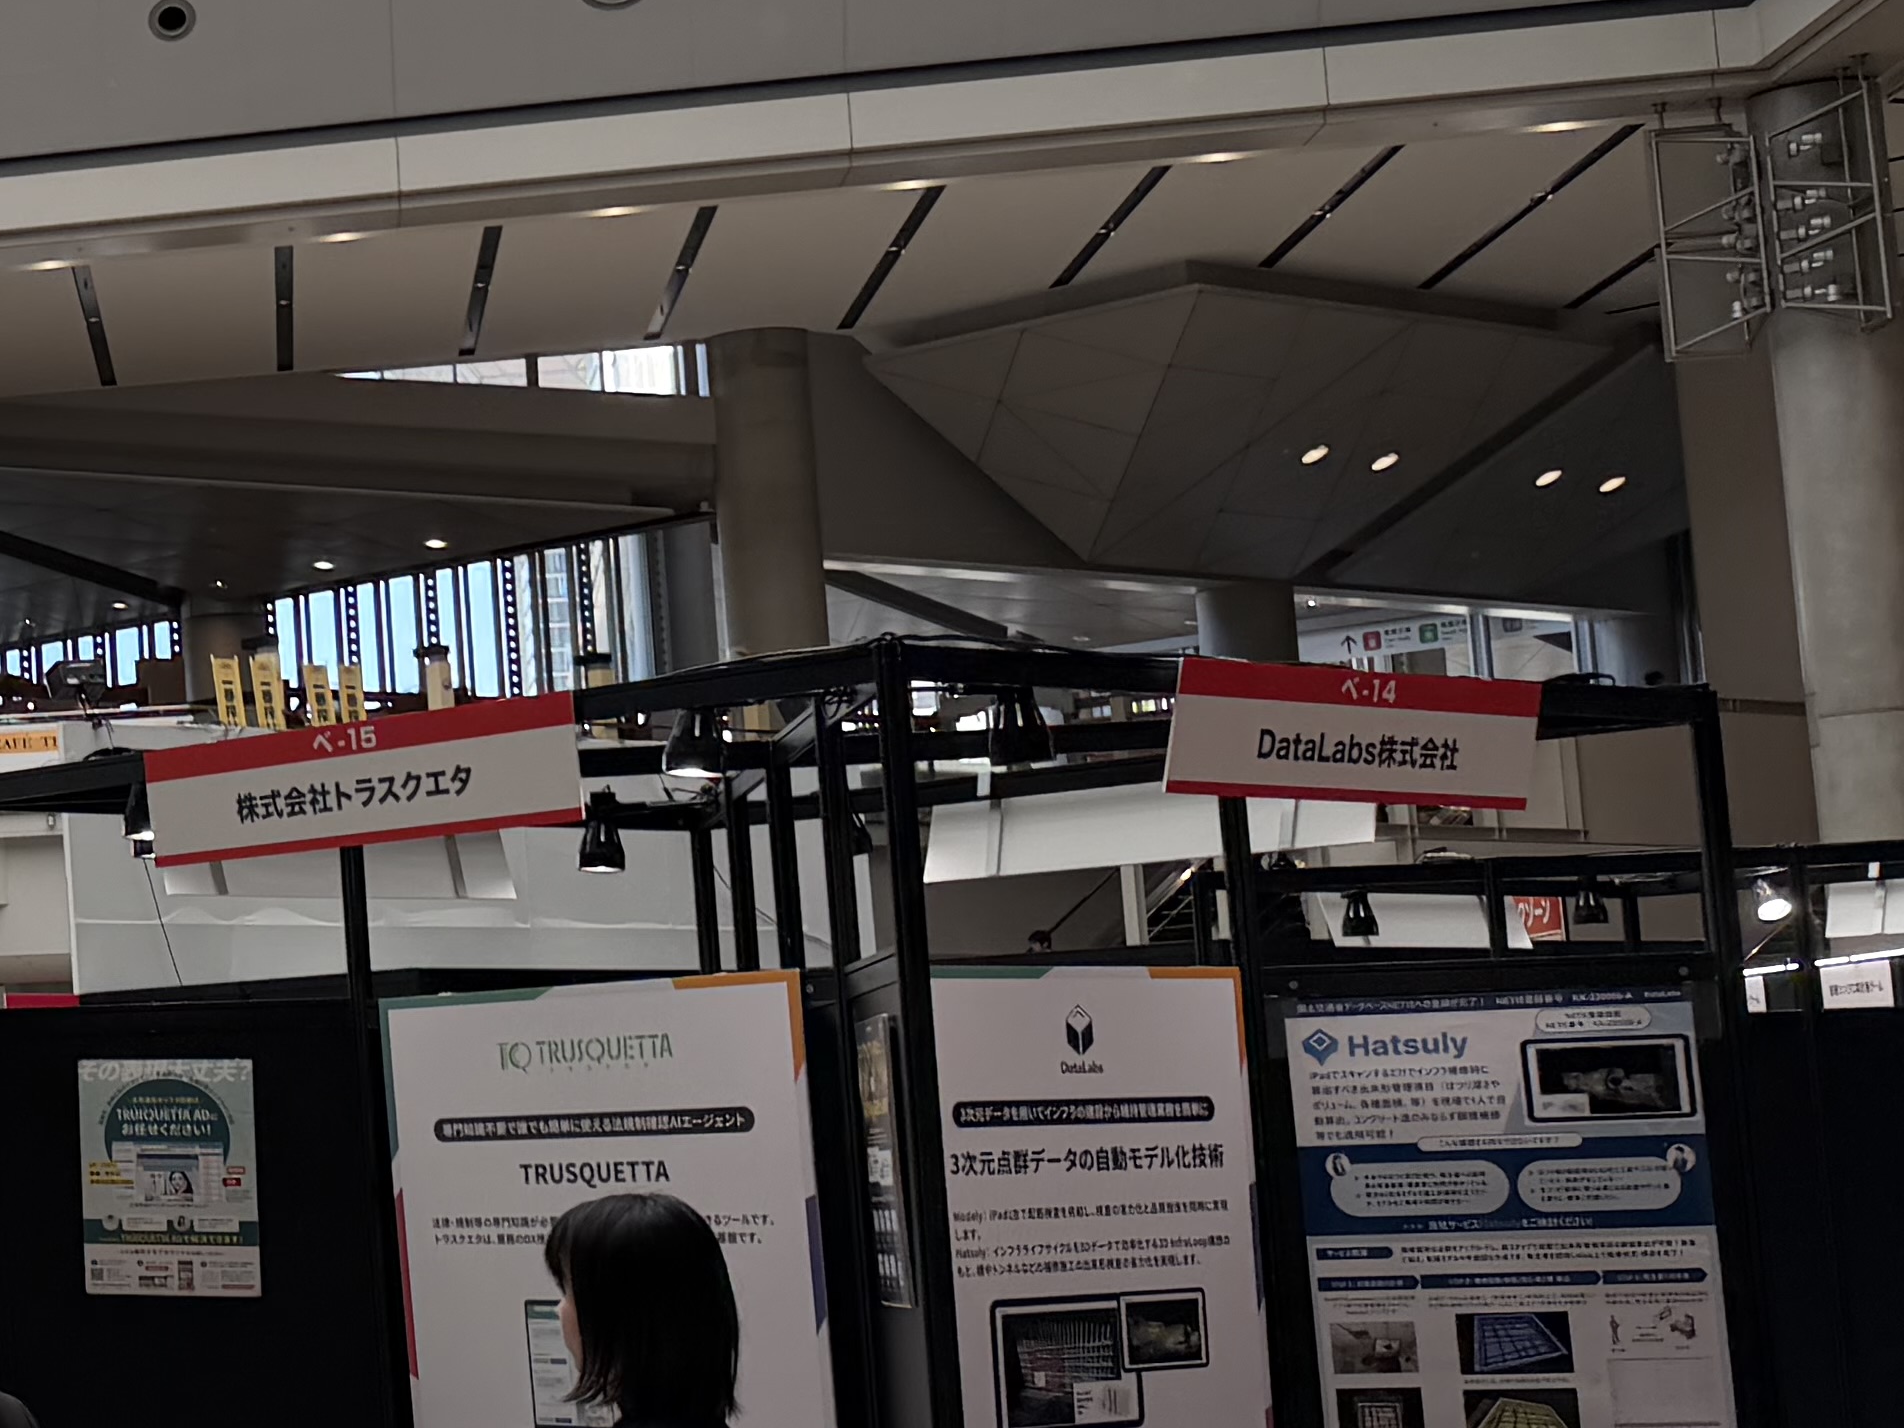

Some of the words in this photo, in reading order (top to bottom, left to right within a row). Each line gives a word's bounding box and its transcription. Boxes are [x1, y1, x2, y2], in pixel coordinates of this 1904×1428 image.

[1256, 728, 1460, 771] DataLabs株式会社
[236, 765, 472, 824] 株式会社トラスクエタ
[535, 1032, 673, 1064] TRUSQUETTA
[1347, 1032, 1469, 1059] Hatsuly
[520, 1160, 670, 1188] TRUSQUETTA
[950, 1143, 1224, 1176] 3次元点群データの自動モデル化技術
